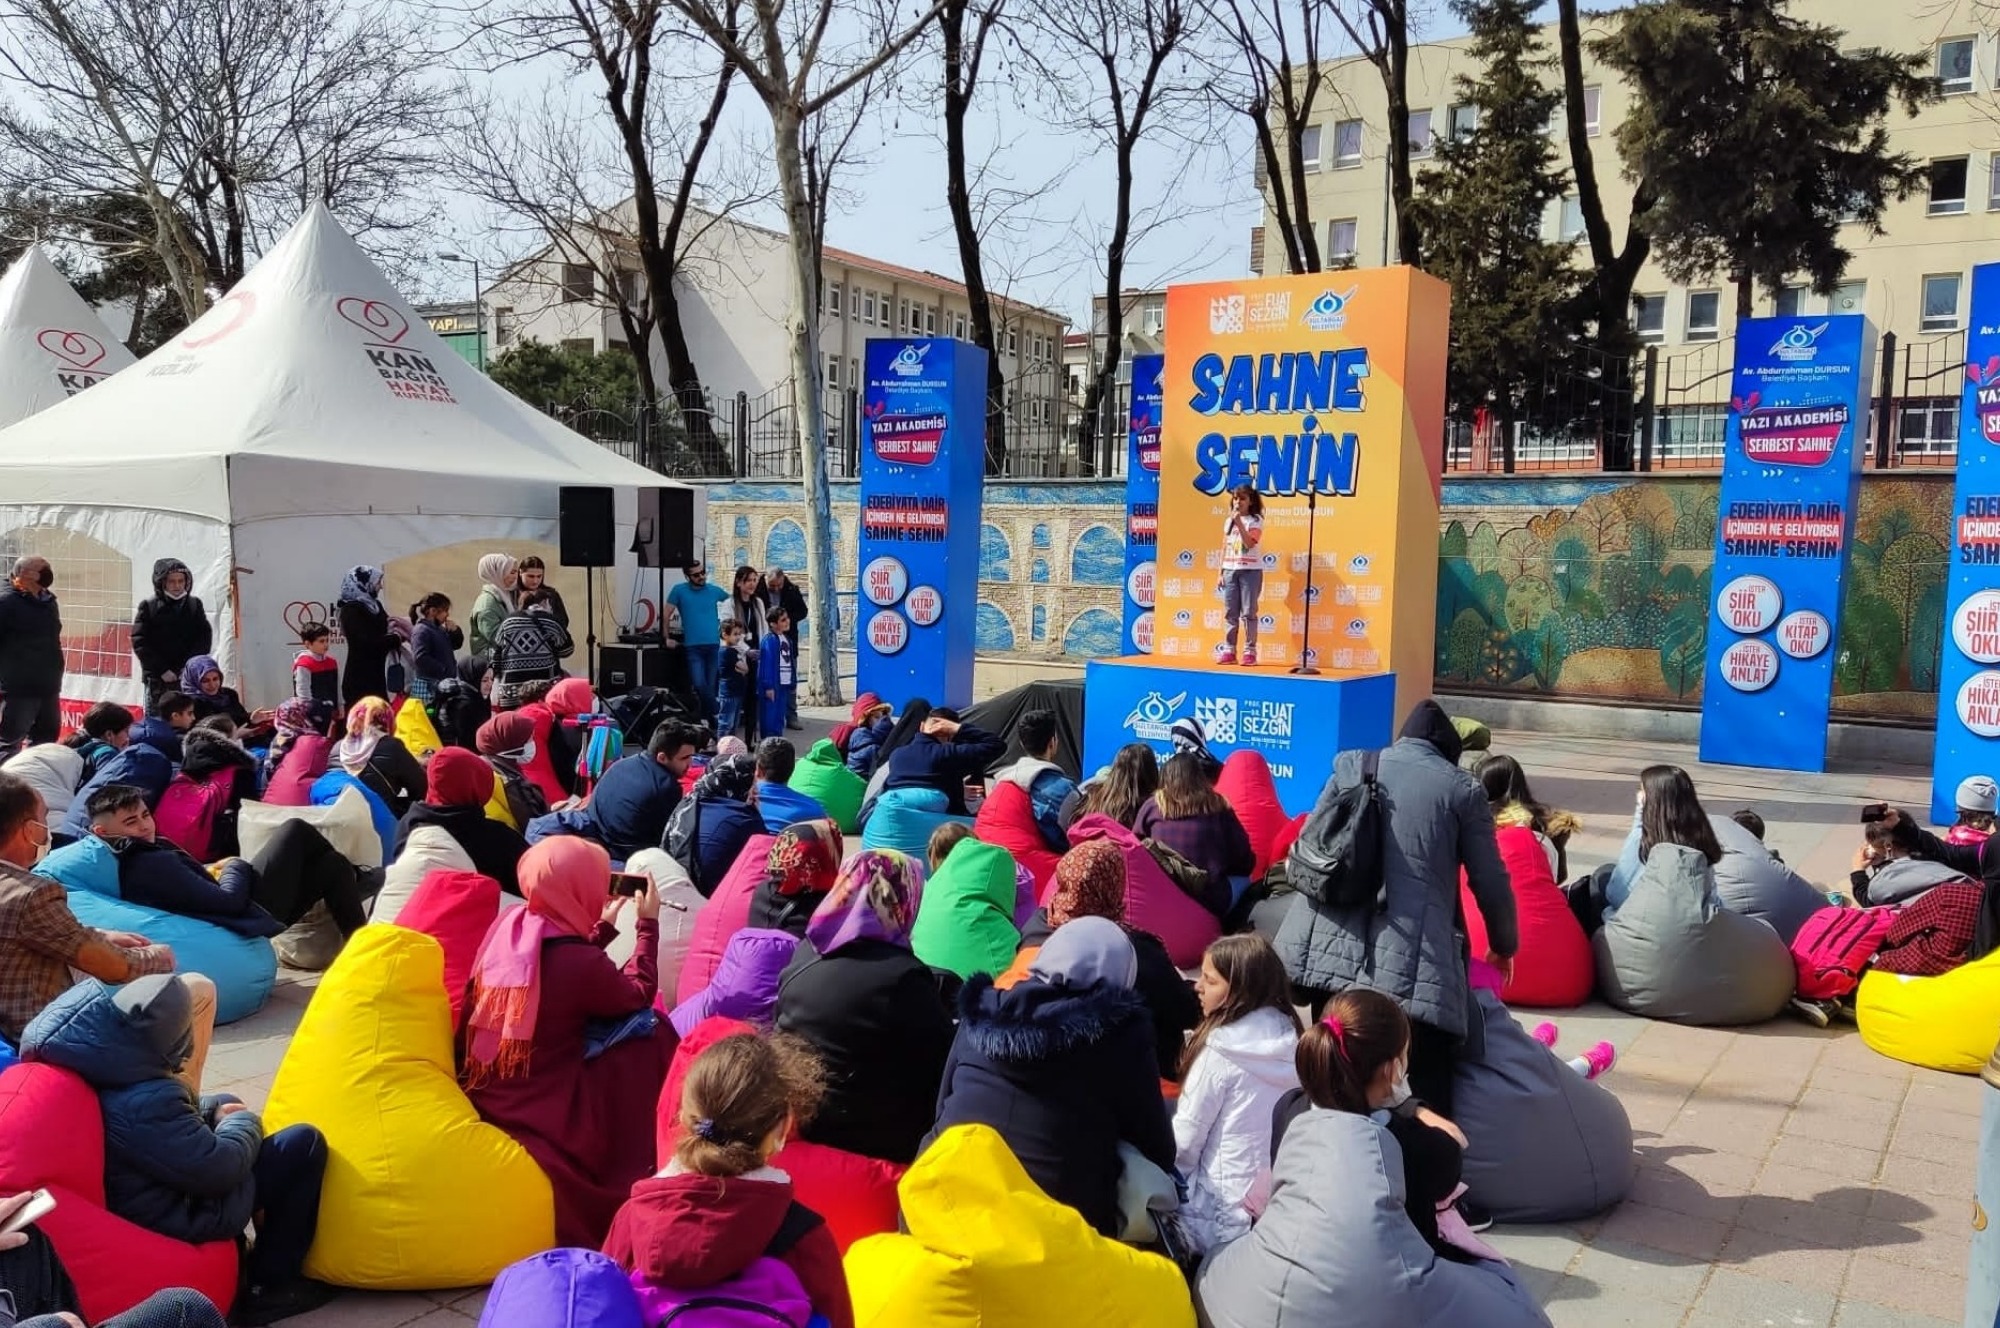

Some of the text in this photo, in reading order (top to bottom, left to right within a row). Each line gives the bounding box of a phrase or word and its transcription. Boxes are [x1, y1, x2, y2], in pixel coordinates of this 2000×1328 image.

[428, 318, 458, 332] YAPI
[1980, 326, 1995, 335] Av.
[365, 349, 437, 374] KAN
[1742, 365, 1850, 375] Av. Abdurrahman DURSUN
[58, 373, 105, 389] KA
[386, 380, 450, 398] HAYAT
[1189, 347, 1370, 416] SAHNE
[872, 415, 947, 434] YAZI AKADEMİSİ
[1741, 406, 1848, 430] YAZI AKADEMİSİ
[878, 440, 937, 454] SERBEST SAHNE
[1137, 434, 1156, 444] YAZI
[1749, 437, 1833, 453] SERBEST SAHNE
[1193, 415, 1360, 498] SENİN
[867, 494, 945, 510] EDEBİYATA DAİR
[896, 511, 906, 523] NE
[907, 510, 945, 526] GELİYORSA
[1730, 500, 1841, 522] EDEBİYATA DAİR
[865, 526, 945, 542] SAHNE SENİN
[1727, 519, 1840, 537] İÇİNDEN NE GELİYORSA
[1724, 537, 1838, 559] SAHNE SENİN
[873, 587, 894, 601] OKU
[915, 610, 932, 622] OKU
[1733, 610, 1761, 627] OKU
[1785, 622, 1818, 638] KİTAP
[873, 634, 901, 647] ANLAT
[1790, 639, 1813, 654] OKU
[1730, 667, 1768, 682] ANLAT
[1262, 701, 1295, 721] FUAT
[1243, 716, 1291, 738] SEZGİN
